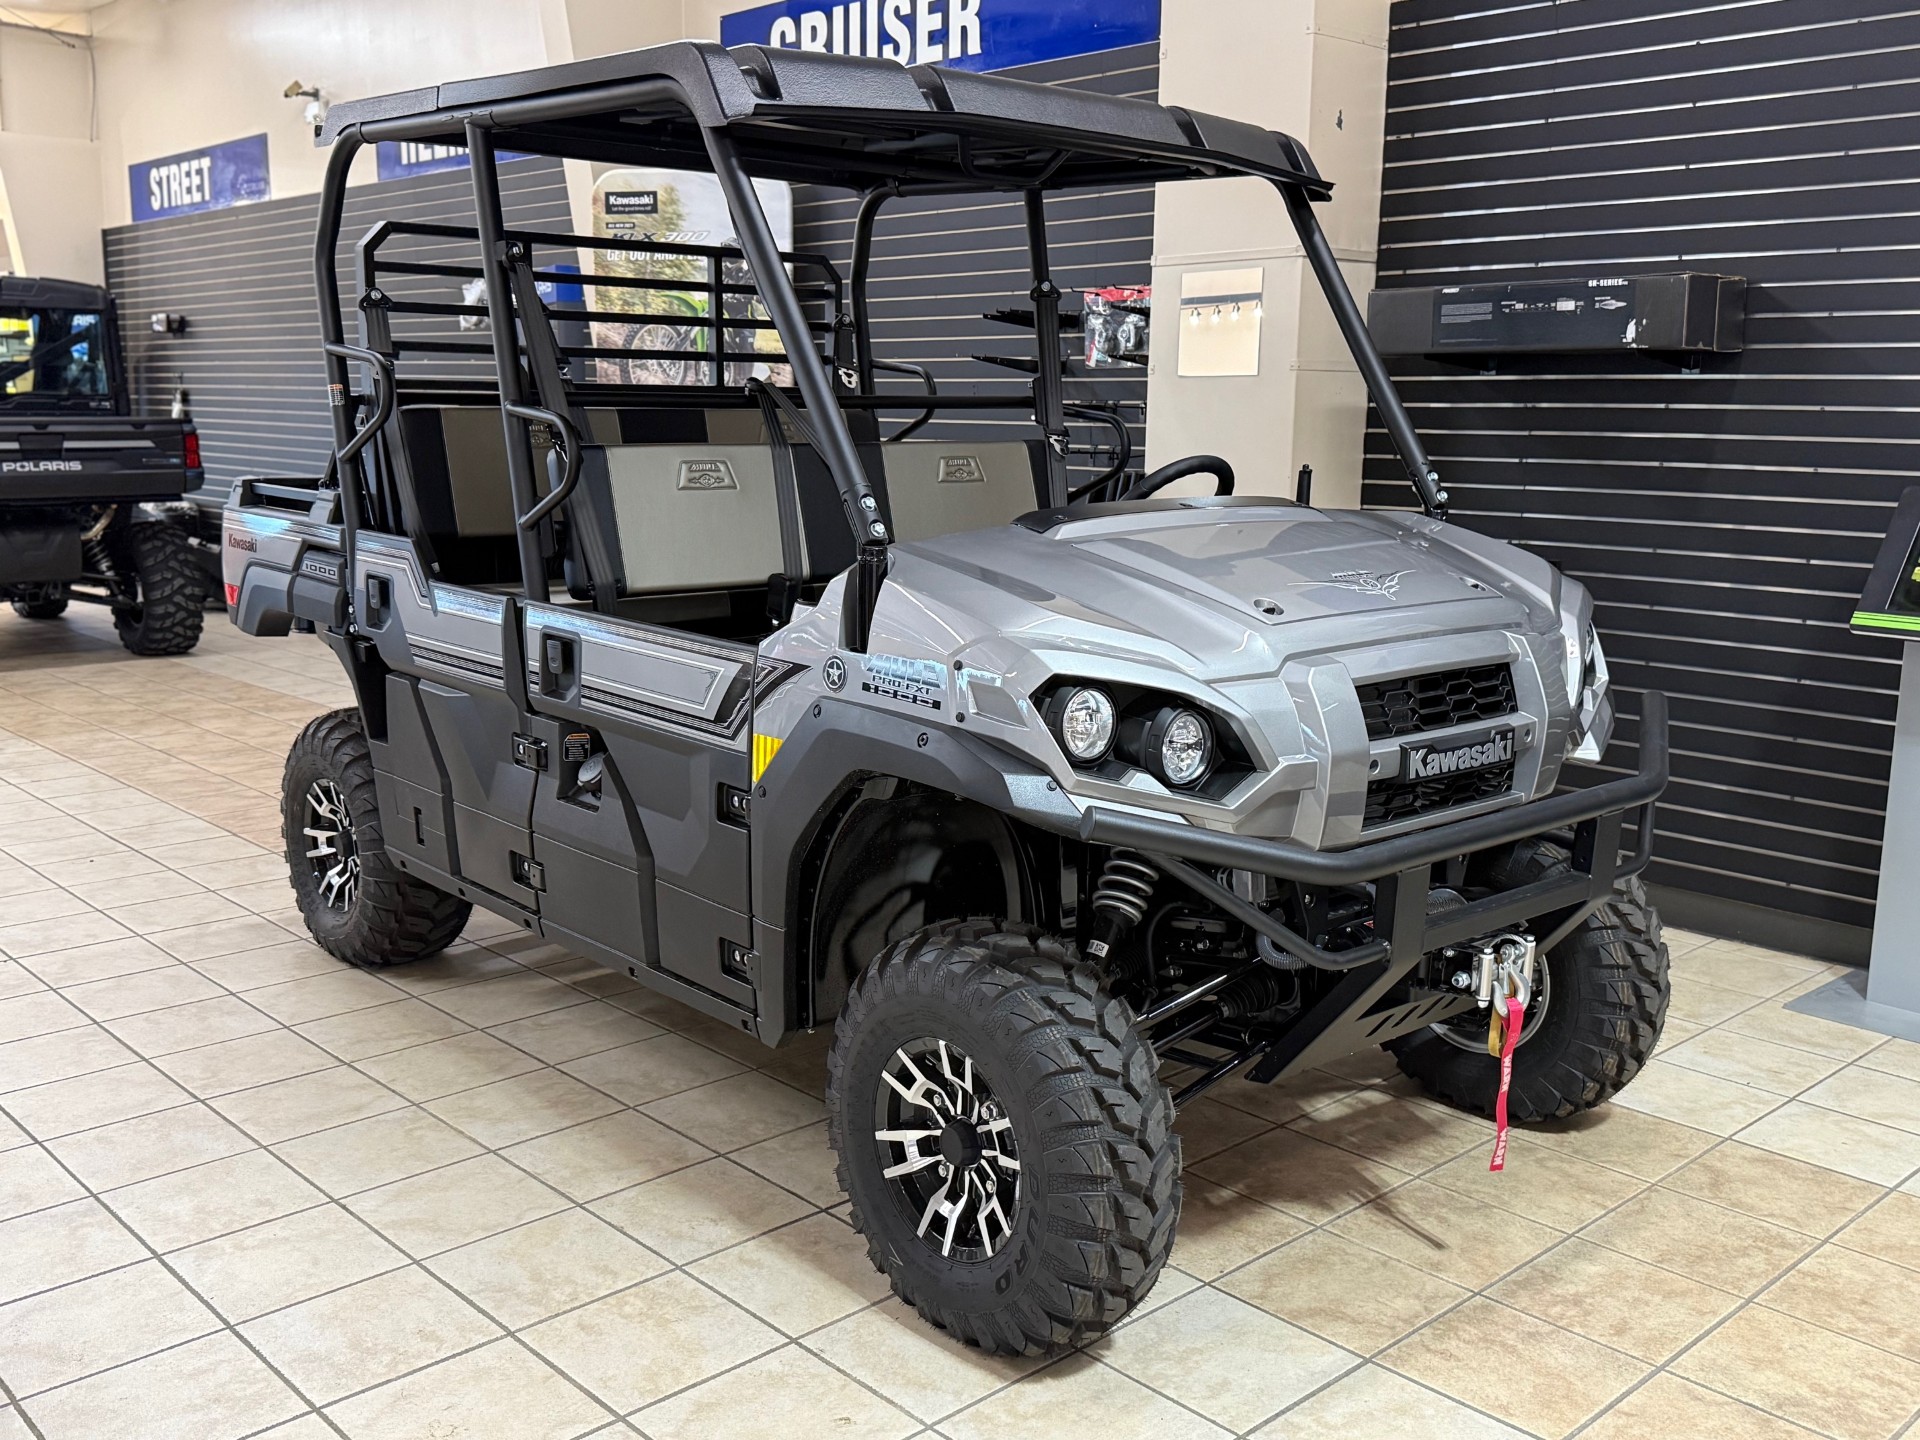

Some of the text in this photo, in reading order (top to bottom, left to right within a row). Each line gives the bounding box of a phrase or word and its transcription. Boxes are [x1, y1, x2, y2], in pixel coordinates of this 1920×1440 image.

[149, 156, 211, 211] STREET
[608, 194, 654, 205] Kawasaki
[661, 231, 710, 242] 300
[2, 460, 82, 472] POLARIS
[228, 533, 257, 553] Kawasaki
[305, 562, 336, 577] 1000
[868, 683, 934, 709] 1000
[872, 674, 933, 696] PRO-FXT
[1409, 731, 1513, 779] Kawasaki
[1501, 1053, 1513, 1093] WARN
[1492, 1127, 1508, 1166] WARN
